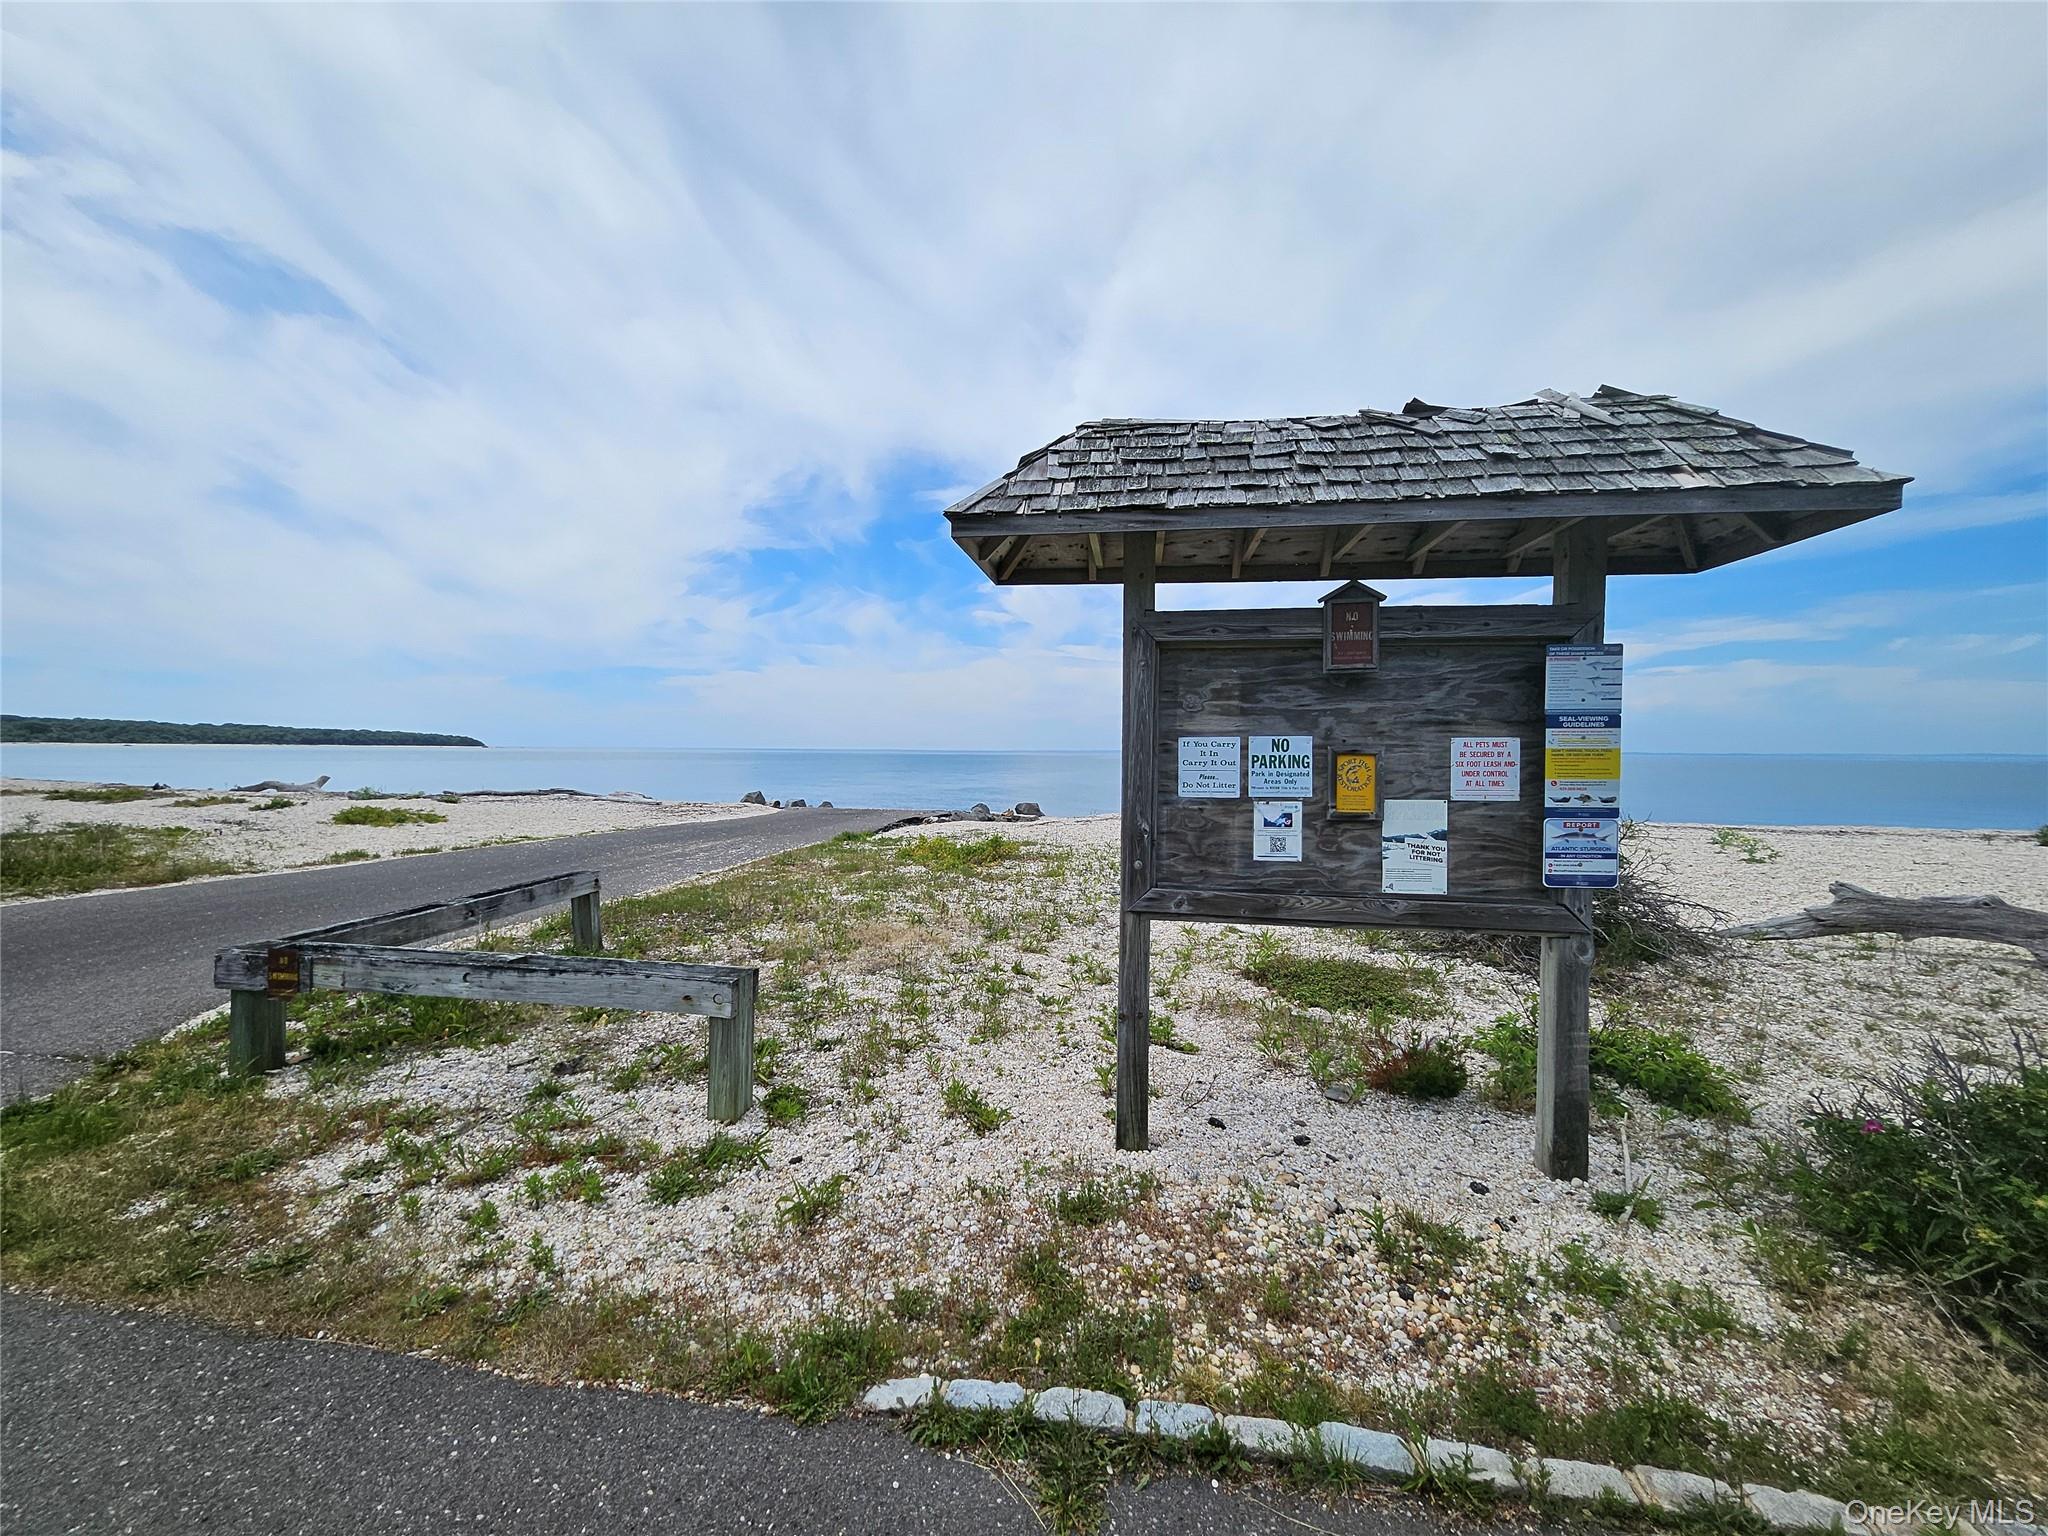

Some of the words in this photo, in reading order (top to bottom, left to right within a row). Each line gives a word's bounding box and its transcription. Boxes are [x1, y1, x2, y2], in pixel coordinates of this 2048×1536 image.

[1345, 611, 1359, 621] NO
[1210, 741, 1237, 749] Carry
[1271, 738, 1290, 753] NO
[1182, 759, 1208, 768] Carry
[1251, 754, 1310, 769] PARKING
[1276, 770, 1310, 778] Designated
[1284, 778, 1297, 786] Only
[1406, 842, 1430, 851] THANK
[1409, 854, 1443, 863] LITTERING
[1426, 850, 1441, 858] NOT
